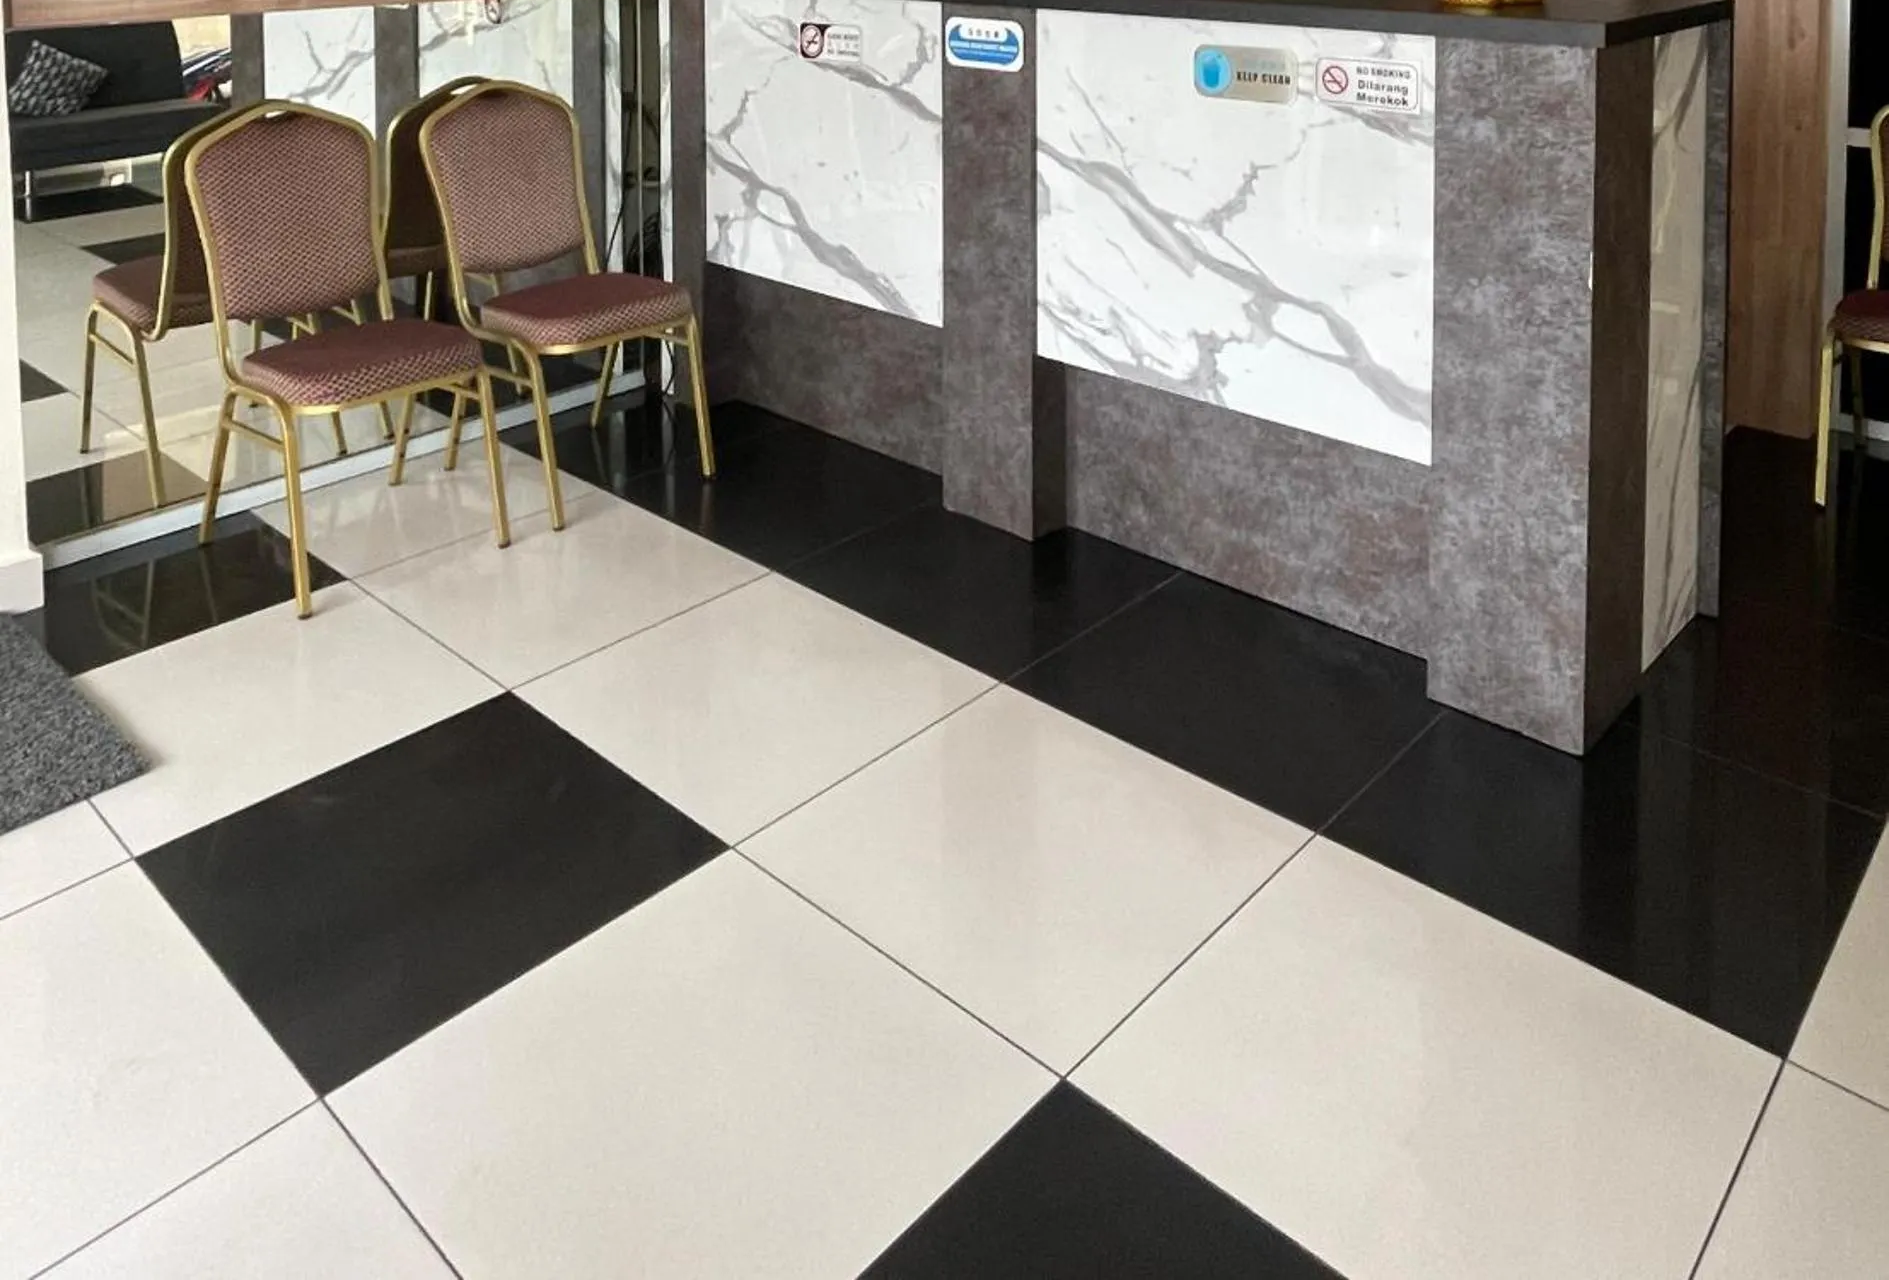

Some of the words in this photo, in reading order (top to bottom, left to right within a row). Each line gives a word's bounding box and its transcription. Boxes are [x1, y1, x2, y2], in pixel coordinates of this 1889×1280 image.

[1261, 73, 1291, 86] CLEAN
[1356, 66, 1369, 76] NO
[1371, 68, 1412, 80] SMOKING
[1357, 80, 1409, 95] Dilarang
[1356, 92, 1409, 107] Merokok
